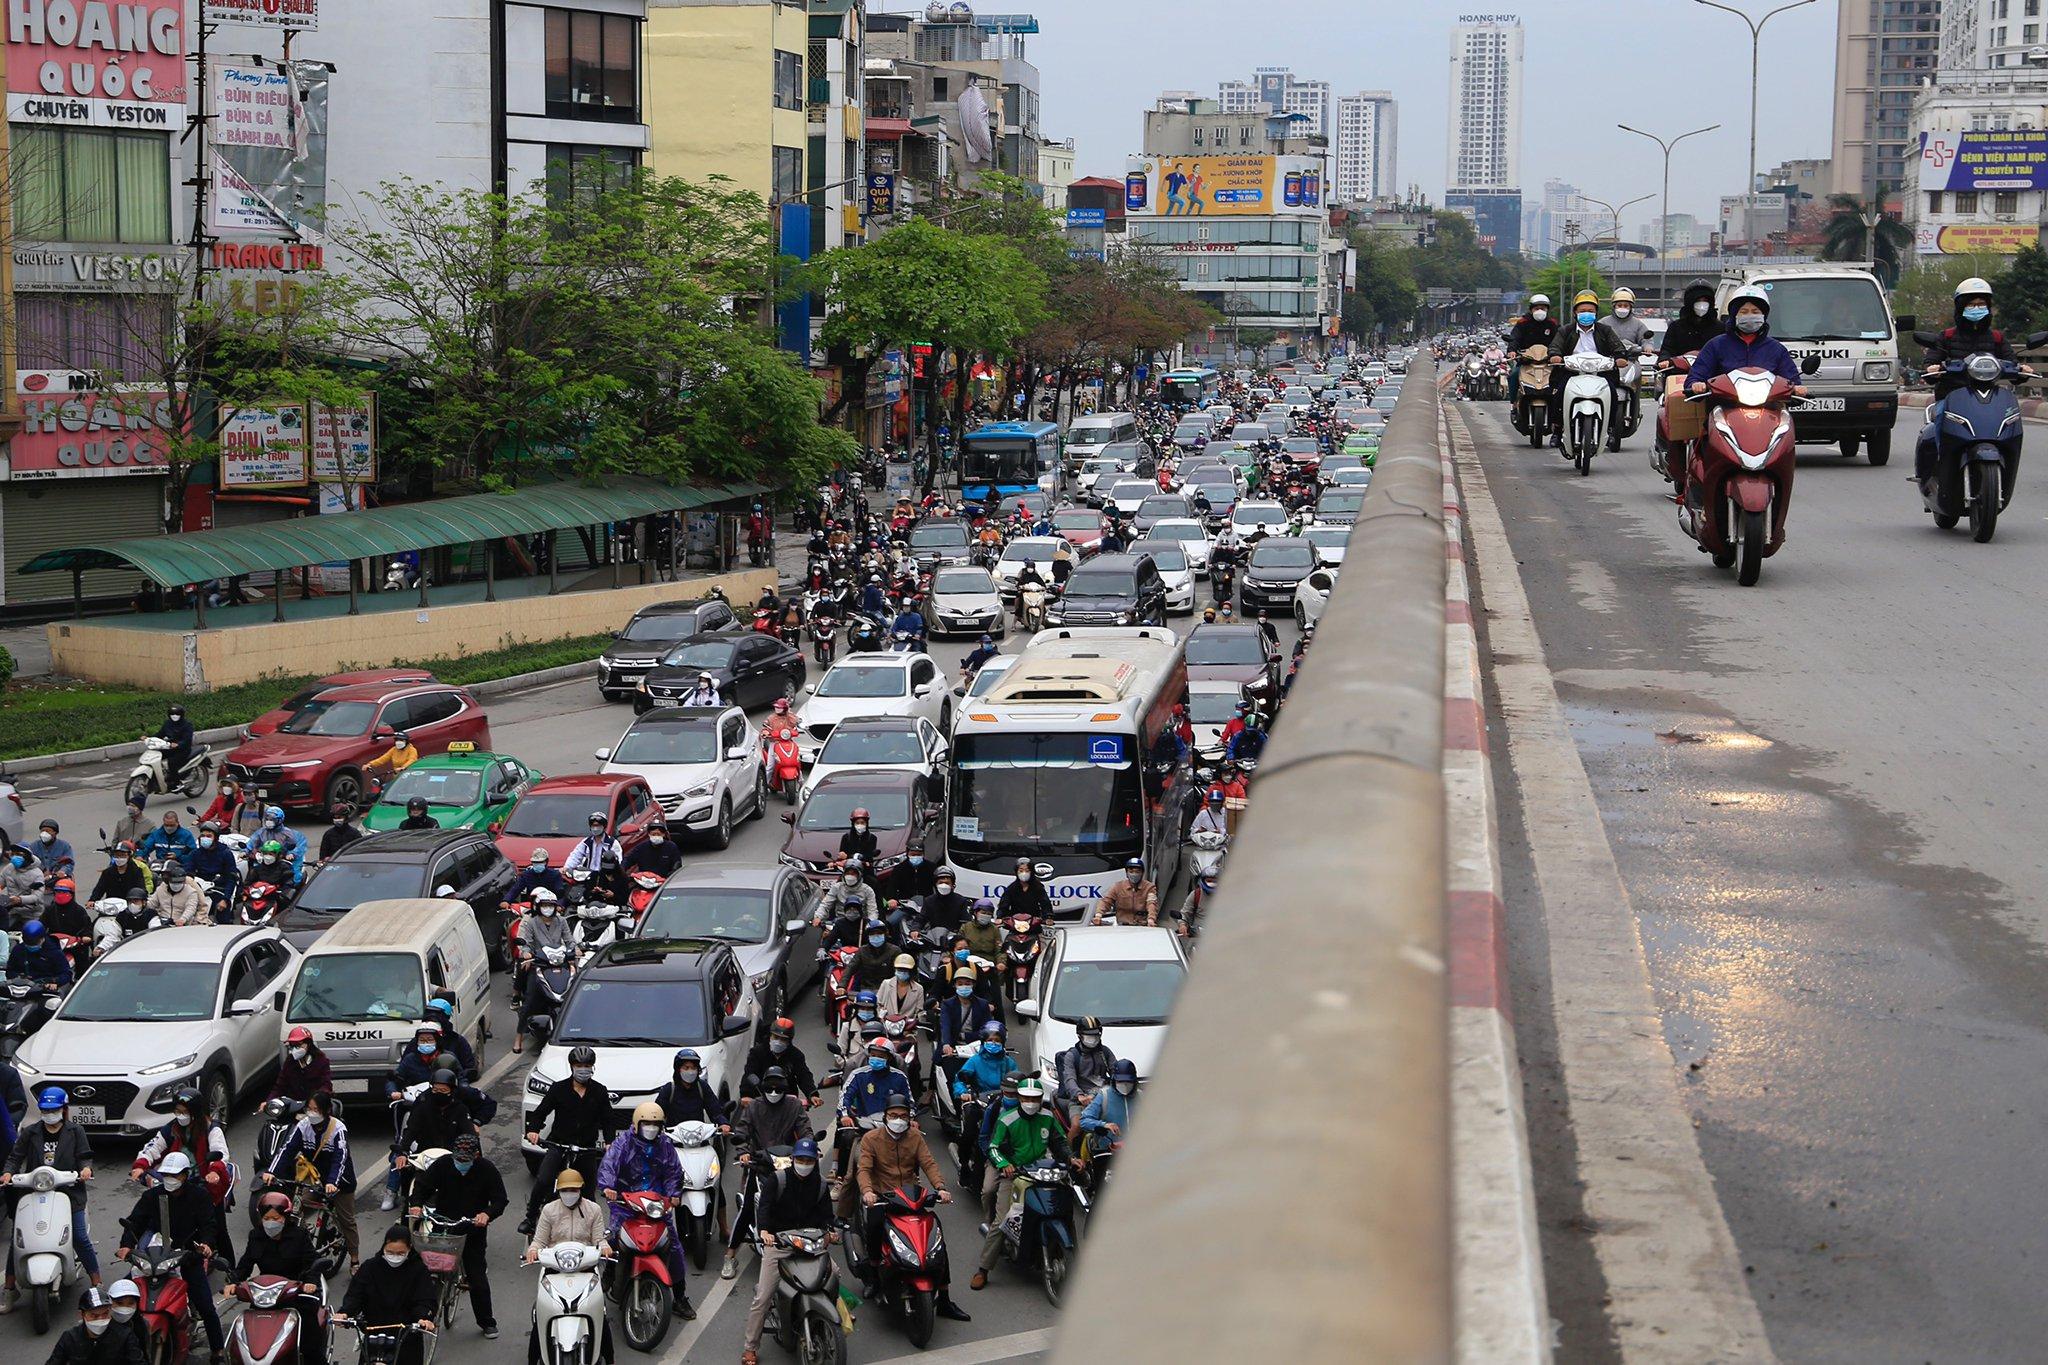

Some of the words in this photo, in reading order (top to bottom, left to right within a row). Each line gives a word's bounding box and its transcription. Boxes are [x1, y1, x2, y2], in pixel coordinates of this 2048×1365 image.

[40, 55, 153, 99] QUỐC
[225, 87, 252, 103] BÚN
[255, 90, 288, 106] RIÊU
[24, 99, 89, 119] CHUYÊN
[107, 105, 166, 123] VESTON
[226, 108, 252, 123] BÚN
[255, 110, 274, 125] CÁ
[226, 128, 261, 144] BÁNH
[2006, 153, 2026, 162] NAM
[2028, 152, 2047, 163] HỌC
[1200, 243, 1237, 251] COFFEE
[213, 242, 284, 269] TRANG
[72, 253, 184, 282] VESTON
[229, 279, 305, 316] LED
[1789, 349, 1849, 358] SUZUKI
[266, 424, 278, 434] CÁ
[325, 1030, 382, 1041] SUZUKI
[78, 1106, 95, 1115] 30G
[72, 1115, 102, 1124] 890.64
